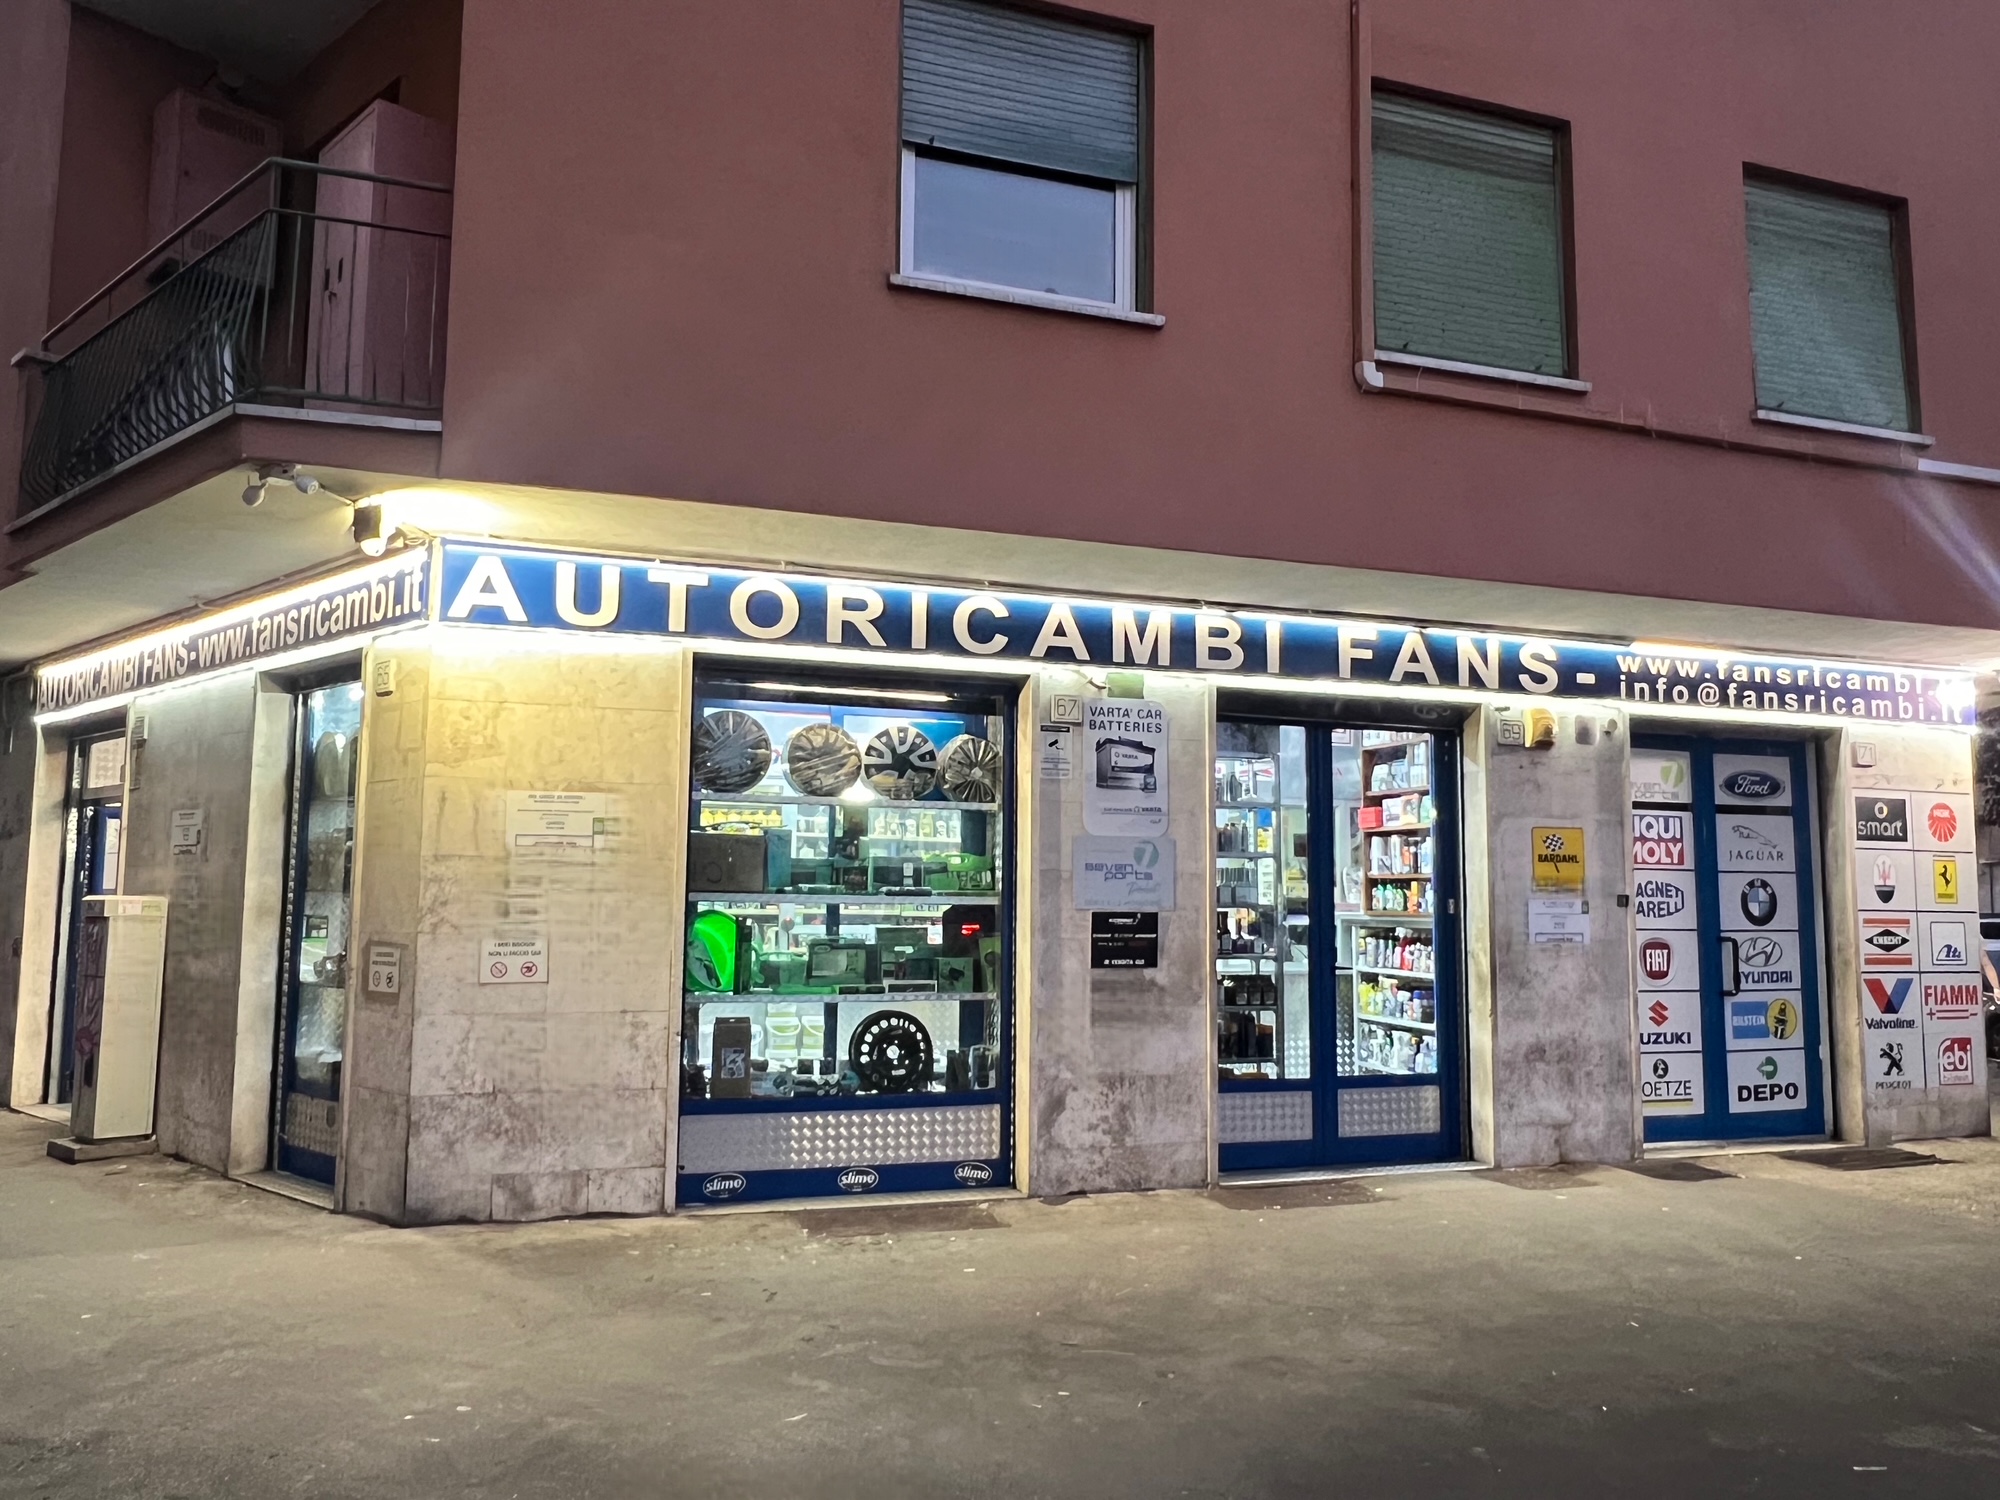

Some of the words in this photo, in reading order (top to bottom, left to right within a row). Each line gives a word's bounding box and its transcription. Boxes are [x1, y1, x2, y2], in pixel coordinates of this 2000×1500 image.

[447, 555, 1281, 673] AUTORICAMBI
[39, 652, 143, 710] AUTORICAMBI
[1056, 698, 1078, 717] 67
[1137, 709, 1162, 720] CAR
[1089, 720, 1162, 733] BATTERIES
[1503, 723, 1521, 739] 69
[1858, 745, 1874, 760] 71
[1734, 774, 1770, 794] Ford
[1633, 815, 1681, 839] IQUI
[1858, 820, 1903, 836] smart
[1537, 853, 1580, 864] BARDAHL
[1729, 850, 1784, 861] JAGUAR
[1646, 949, 1669, 972] FIAT
[1740, 970, 1793, 983] YUNDAI
[1924, 985, 1979, 1005] FIAMM
[1640, 1032, 1692, 1045] UZUKI
[1642, 1080, 1692, 1097] OETZE
[1737, 1083, 1799, 1103] DEPO
